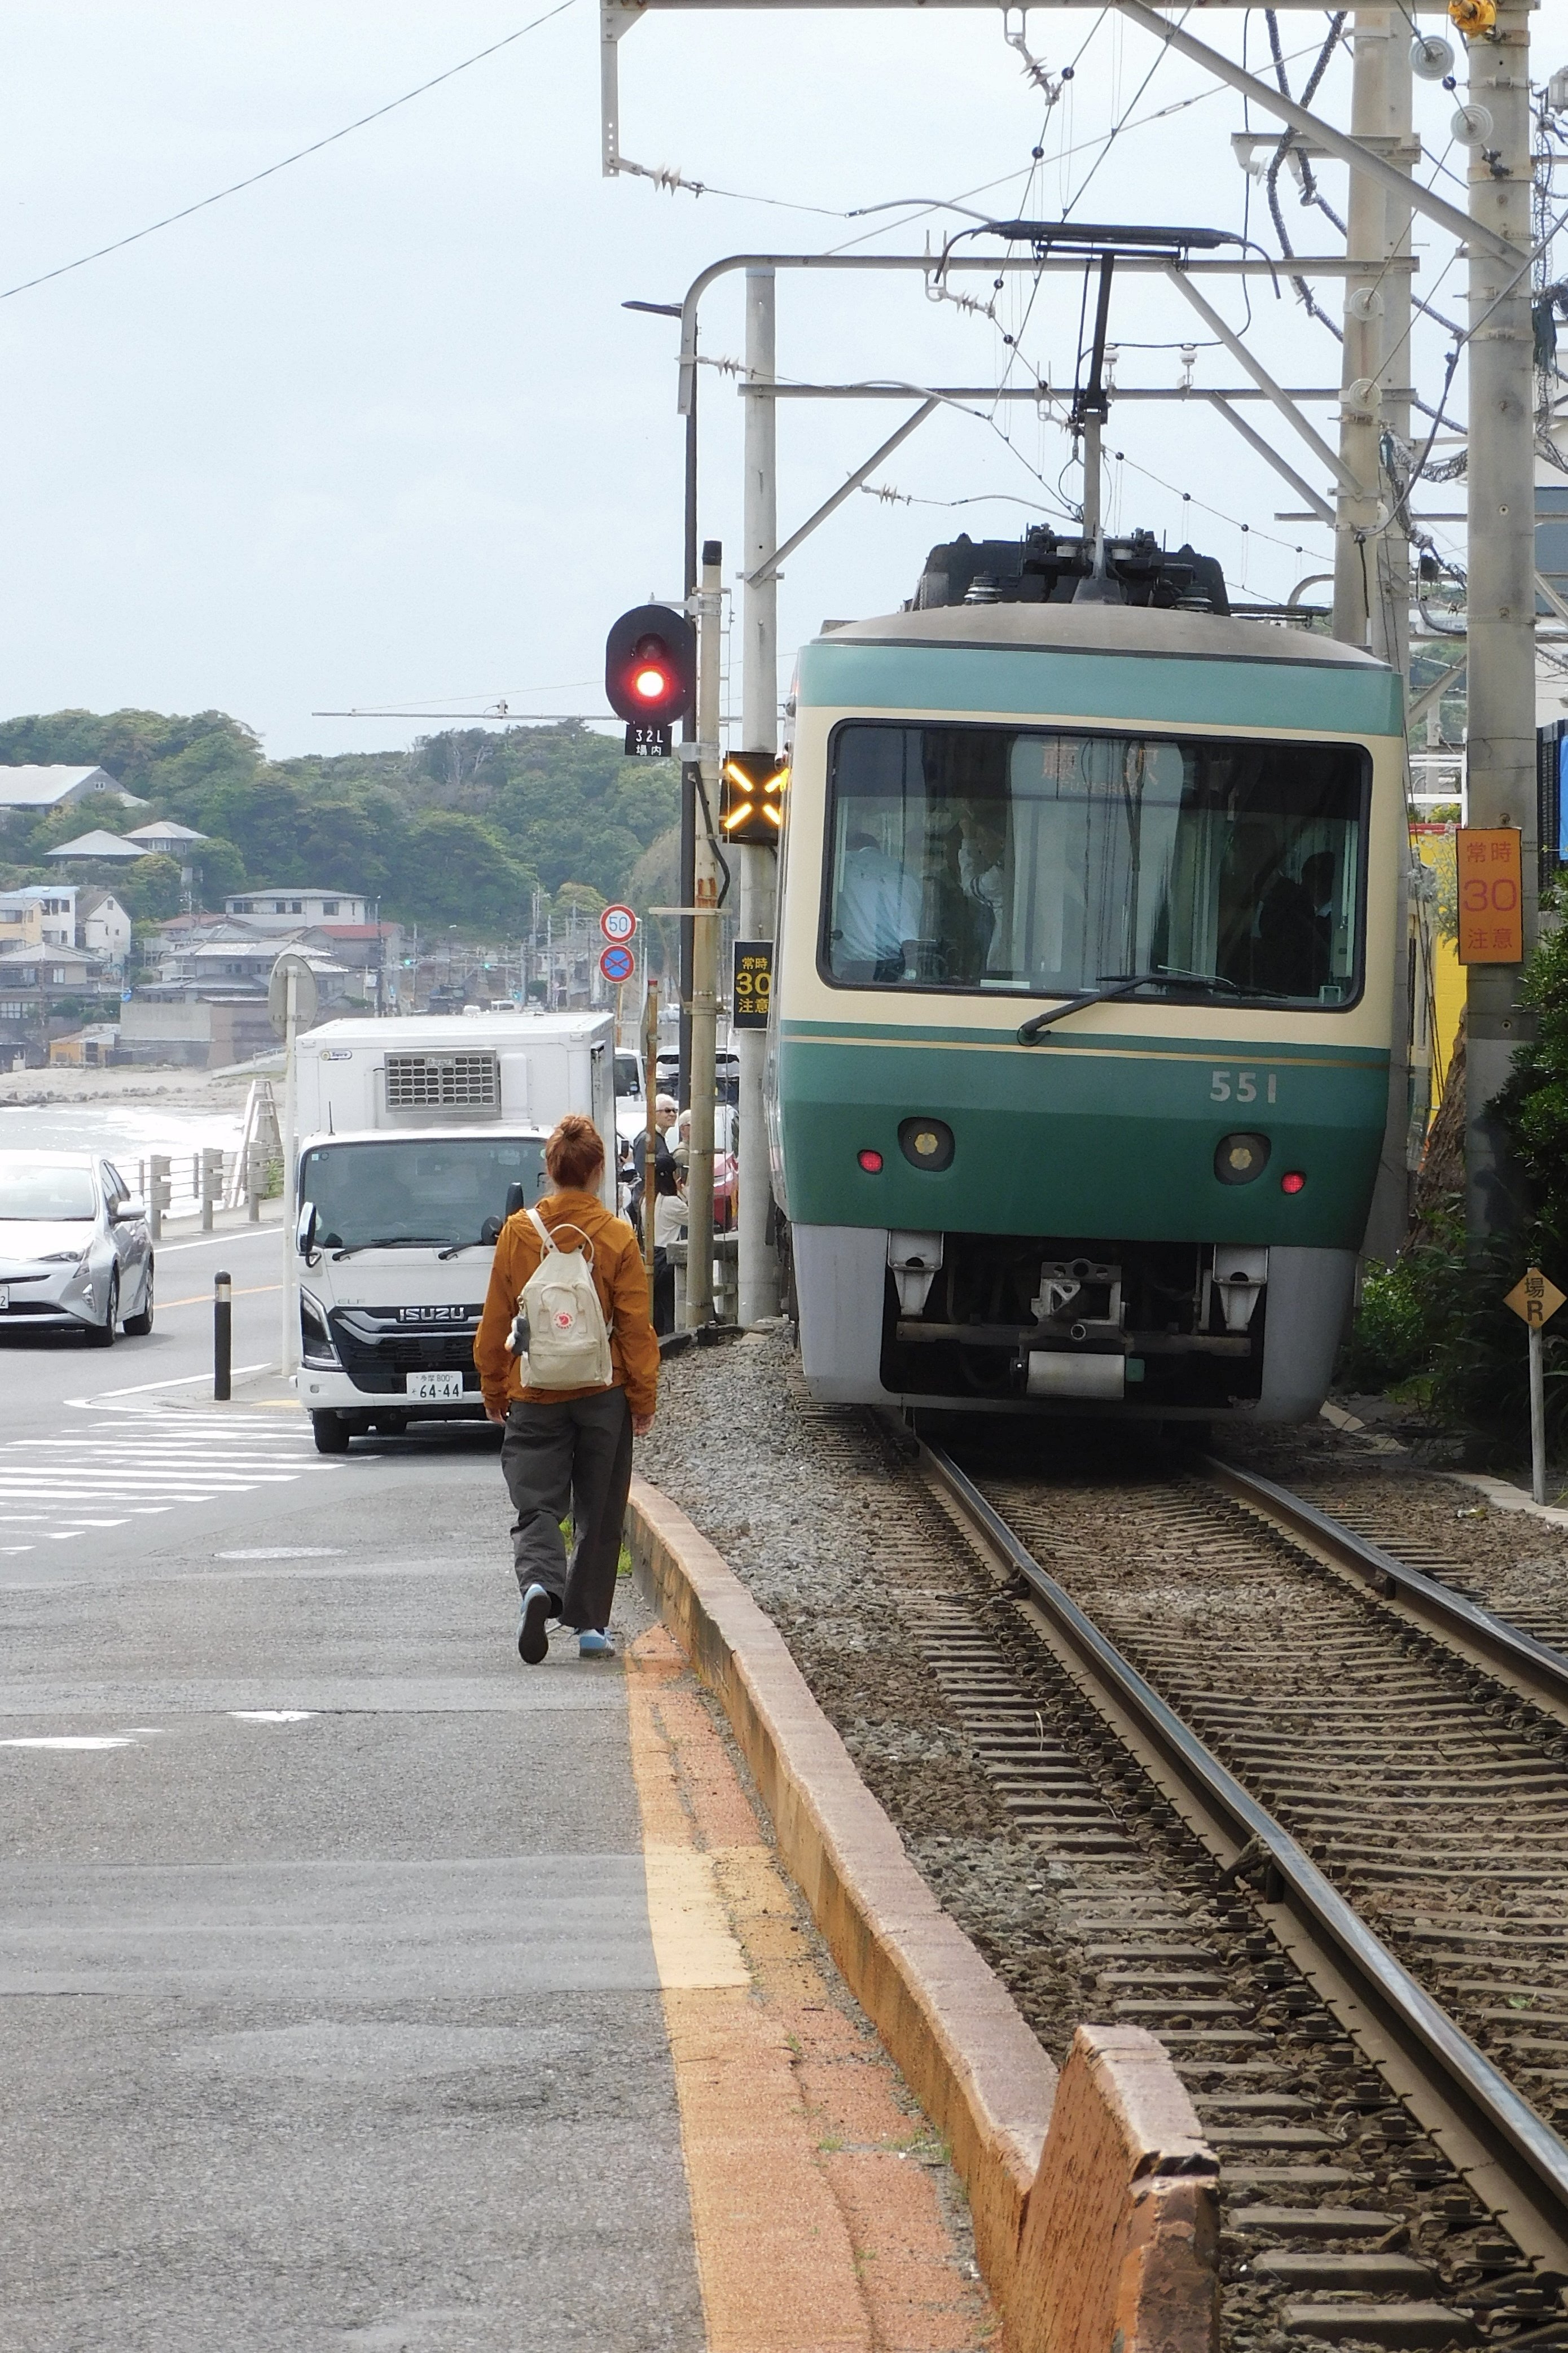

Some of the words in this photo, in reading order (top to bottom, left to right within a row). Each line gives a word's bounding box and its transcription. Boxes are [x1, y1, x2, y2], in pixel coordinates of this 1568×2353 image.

[635, 729, 664, 743] 32L
[636, 744, 662, 756] 場内
[1466, 842, 1512, 863] 常時
[1464, 878, 1518, 912] 30
[609, 916, 628, 932] 50
[1467, 928, 1513, 949] 注意
[741, 957, 768, 970] 常時
[735, 972, 771, 996] 30
[737, 998, 769, 1014] 注意
[1209, 1070, 1277, 1105] 551
[1524, 1277, 1545, 1299] 場
[399, 1307, 465, 1322] ISUZU
[1527, 1300, 1543, 1322] R
[420, 1383, 459, 1398] 64-44
